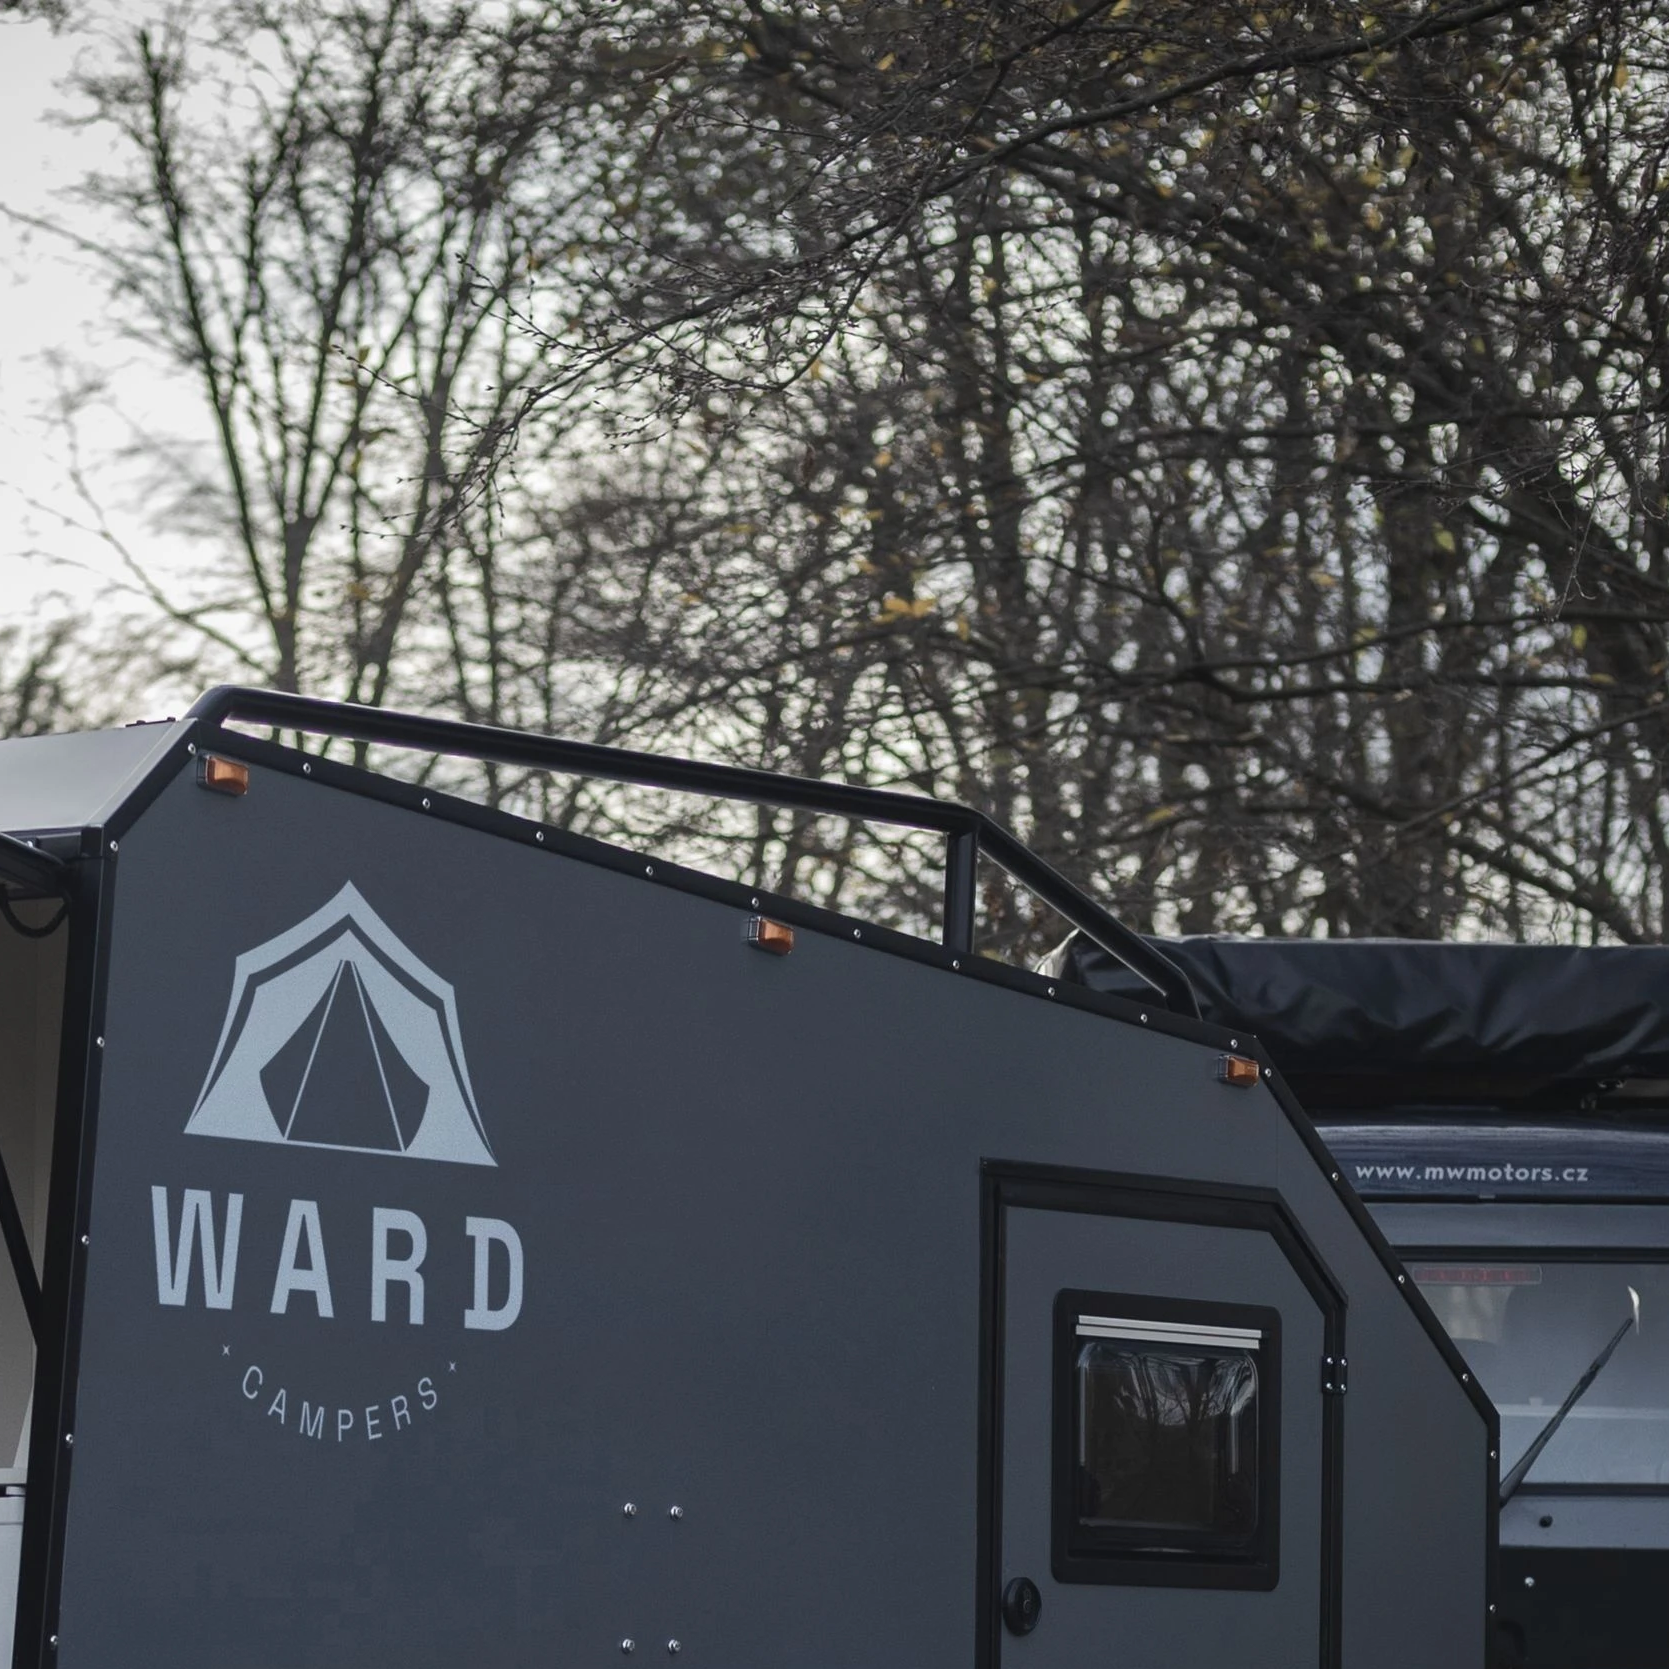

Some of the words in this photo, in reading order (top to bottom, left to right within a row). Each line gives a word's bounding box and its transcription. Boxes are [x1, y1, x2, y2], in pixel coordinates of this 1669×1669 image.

[1355, 1163, 1588, 1182] www.mwmotors.cz
[151, 1185, 524, 1331] WARD
[242, 1365, 438, 1442] CAMPERS
